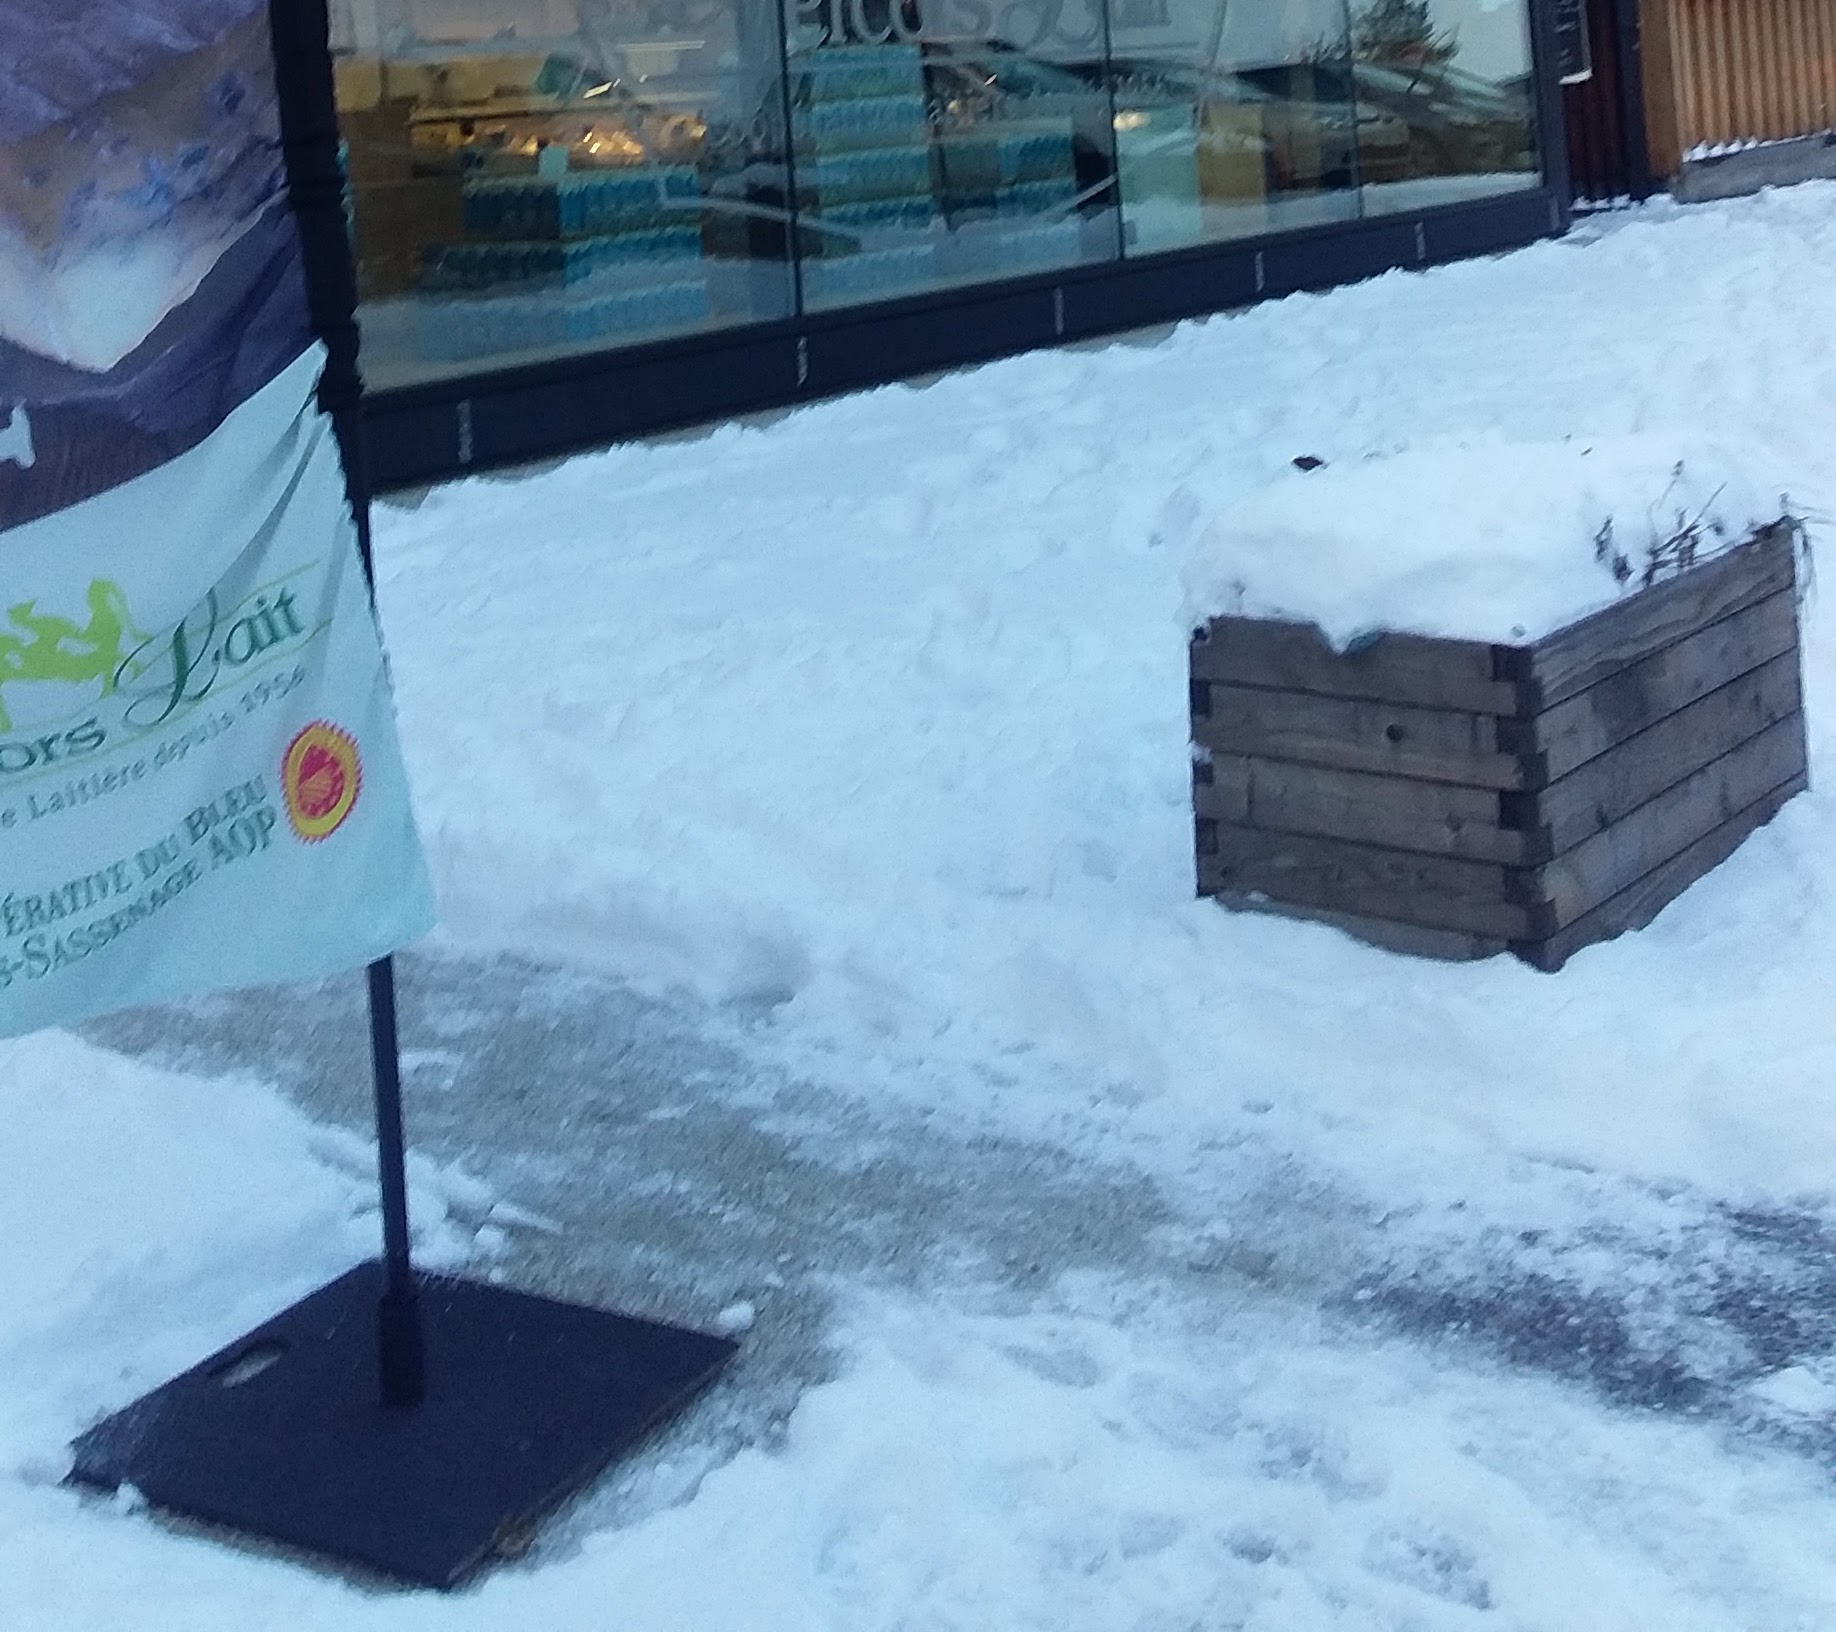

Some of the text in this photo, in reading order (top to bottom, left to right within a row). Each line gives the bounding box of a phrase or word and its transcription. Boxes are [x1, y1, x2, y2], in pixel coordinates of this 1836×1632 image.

[113, 586, 305, 728] Lait
[134, 833, 181, 881] DU
[183, 774, 267, 846] BLEU
[208, 804, 278, 870] AOP
